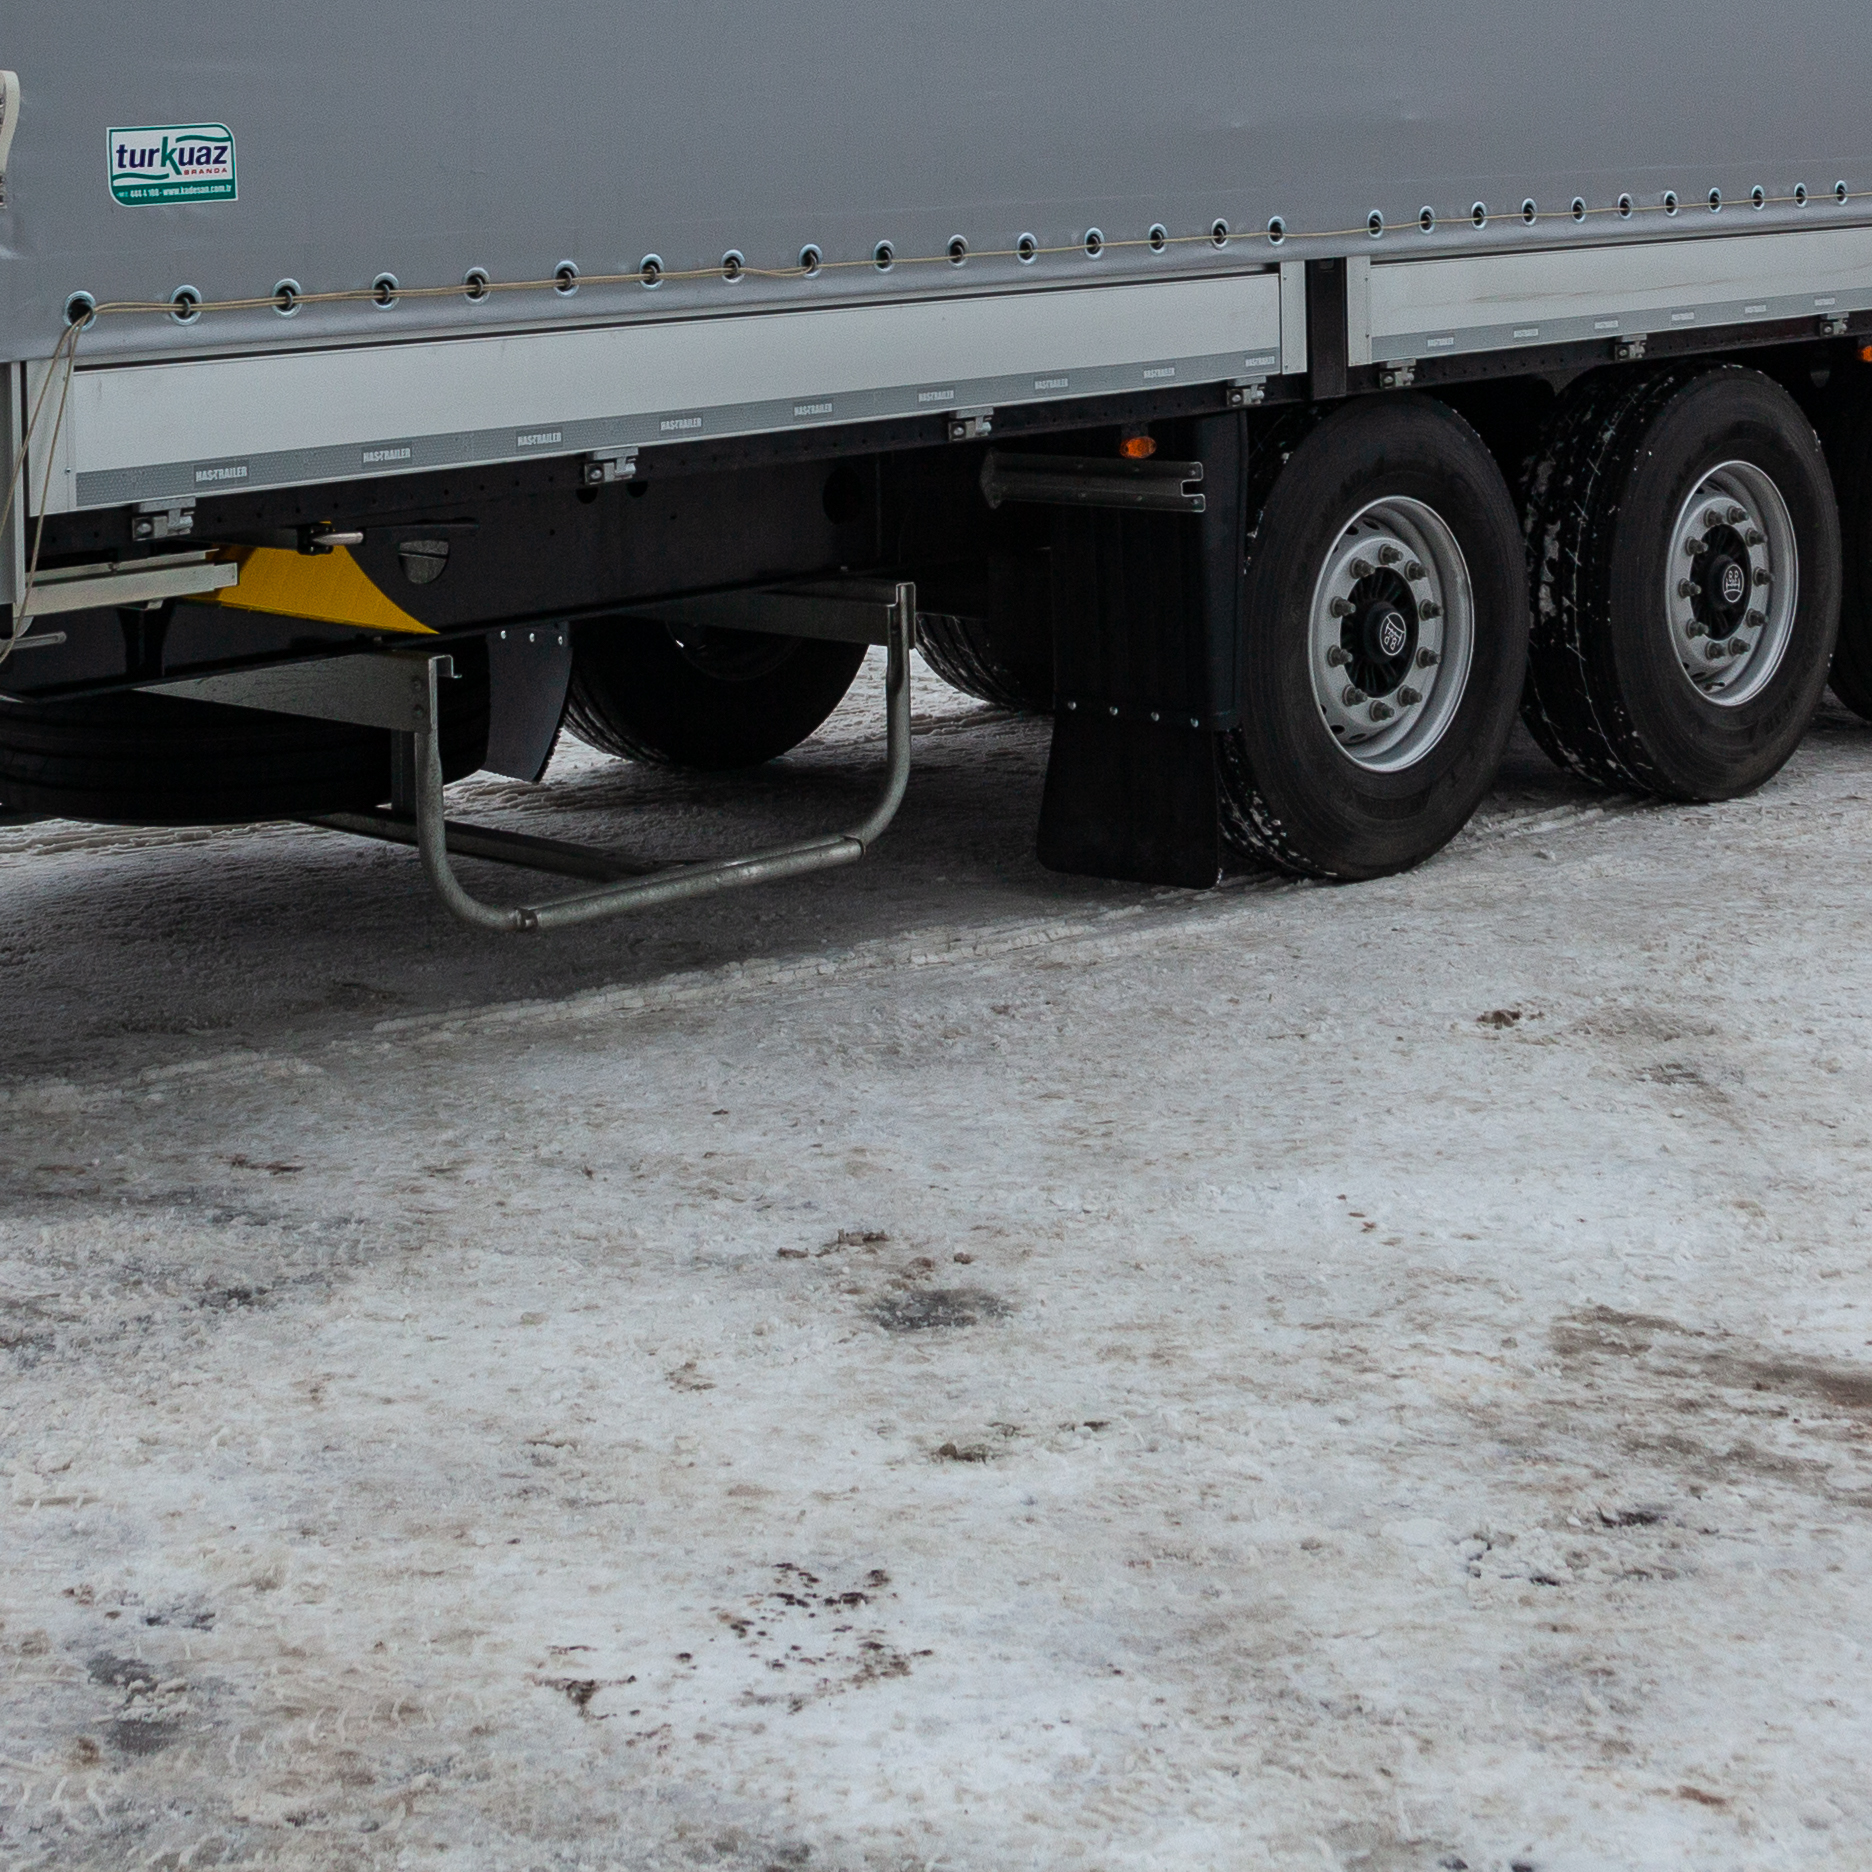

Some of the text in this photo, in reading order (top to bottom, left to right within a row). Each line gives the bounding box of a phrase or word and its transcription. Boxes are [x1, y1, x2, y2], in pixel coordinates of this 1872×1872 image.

[116, 136, 228, 175] turkuaz
[184, 167, 228, 176] BRANDA
[363, 447, 411, 464] HASTRAILER
[195, 465, 248, 482] HASTRAILER
